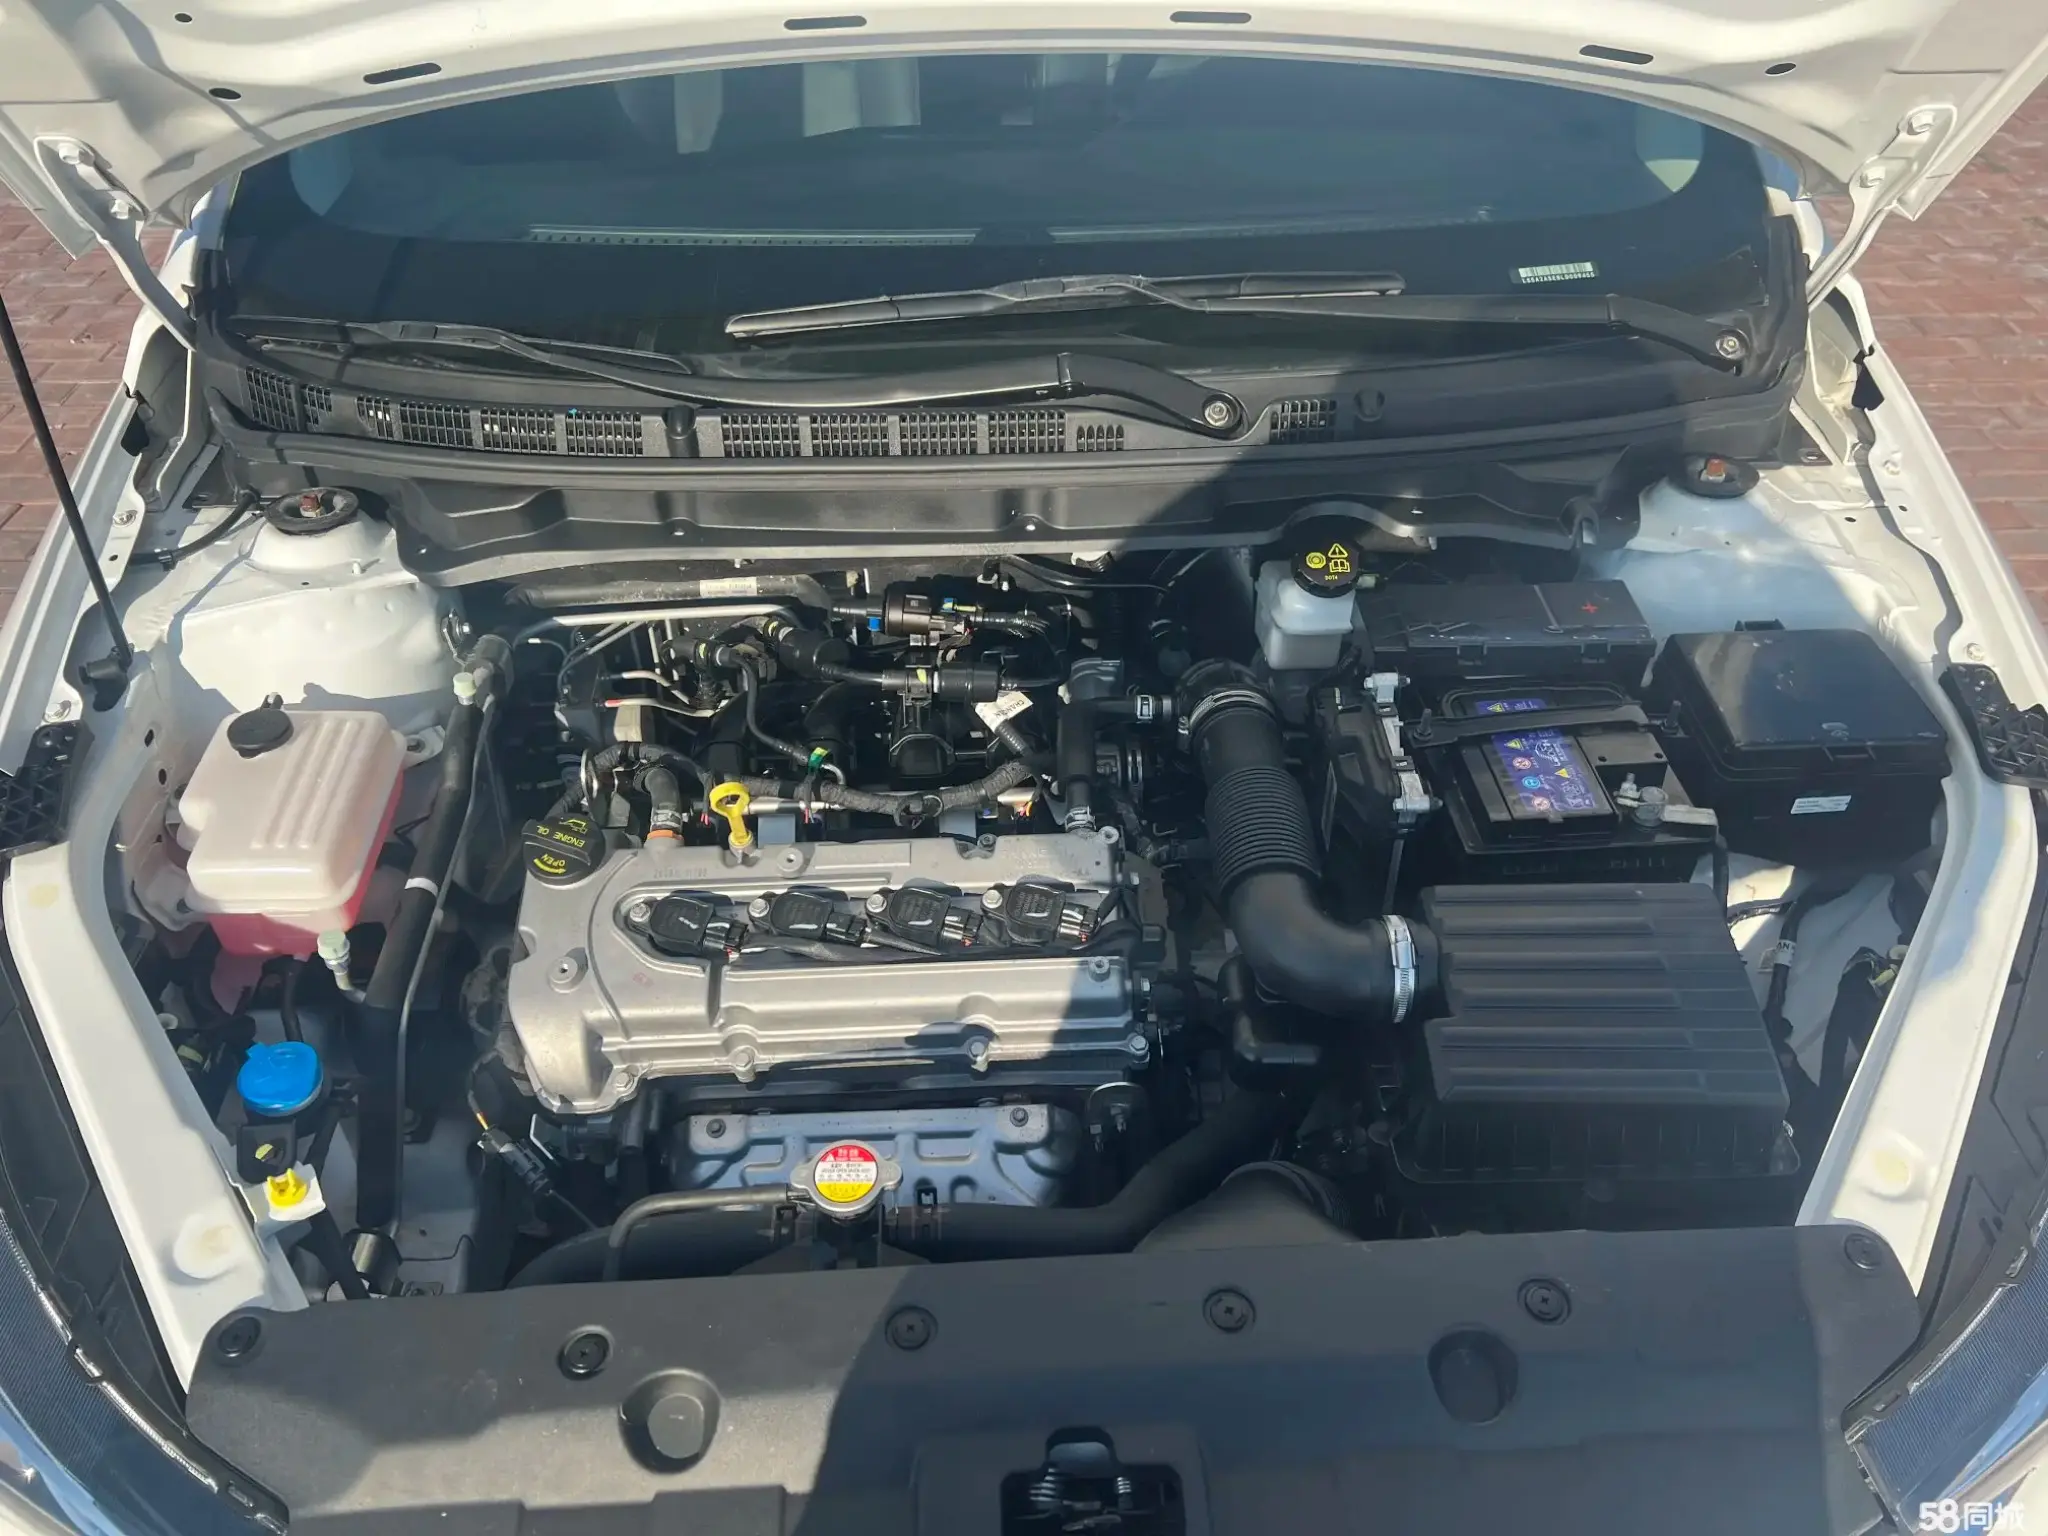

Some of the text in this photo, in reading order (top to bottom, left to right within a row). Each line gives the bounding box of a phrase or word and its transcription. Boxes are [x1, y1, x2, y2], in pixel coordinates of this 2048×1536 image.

[536, 825, 586, 848] ENGINE OIL
[541, 853, 566, 867] OPEN
